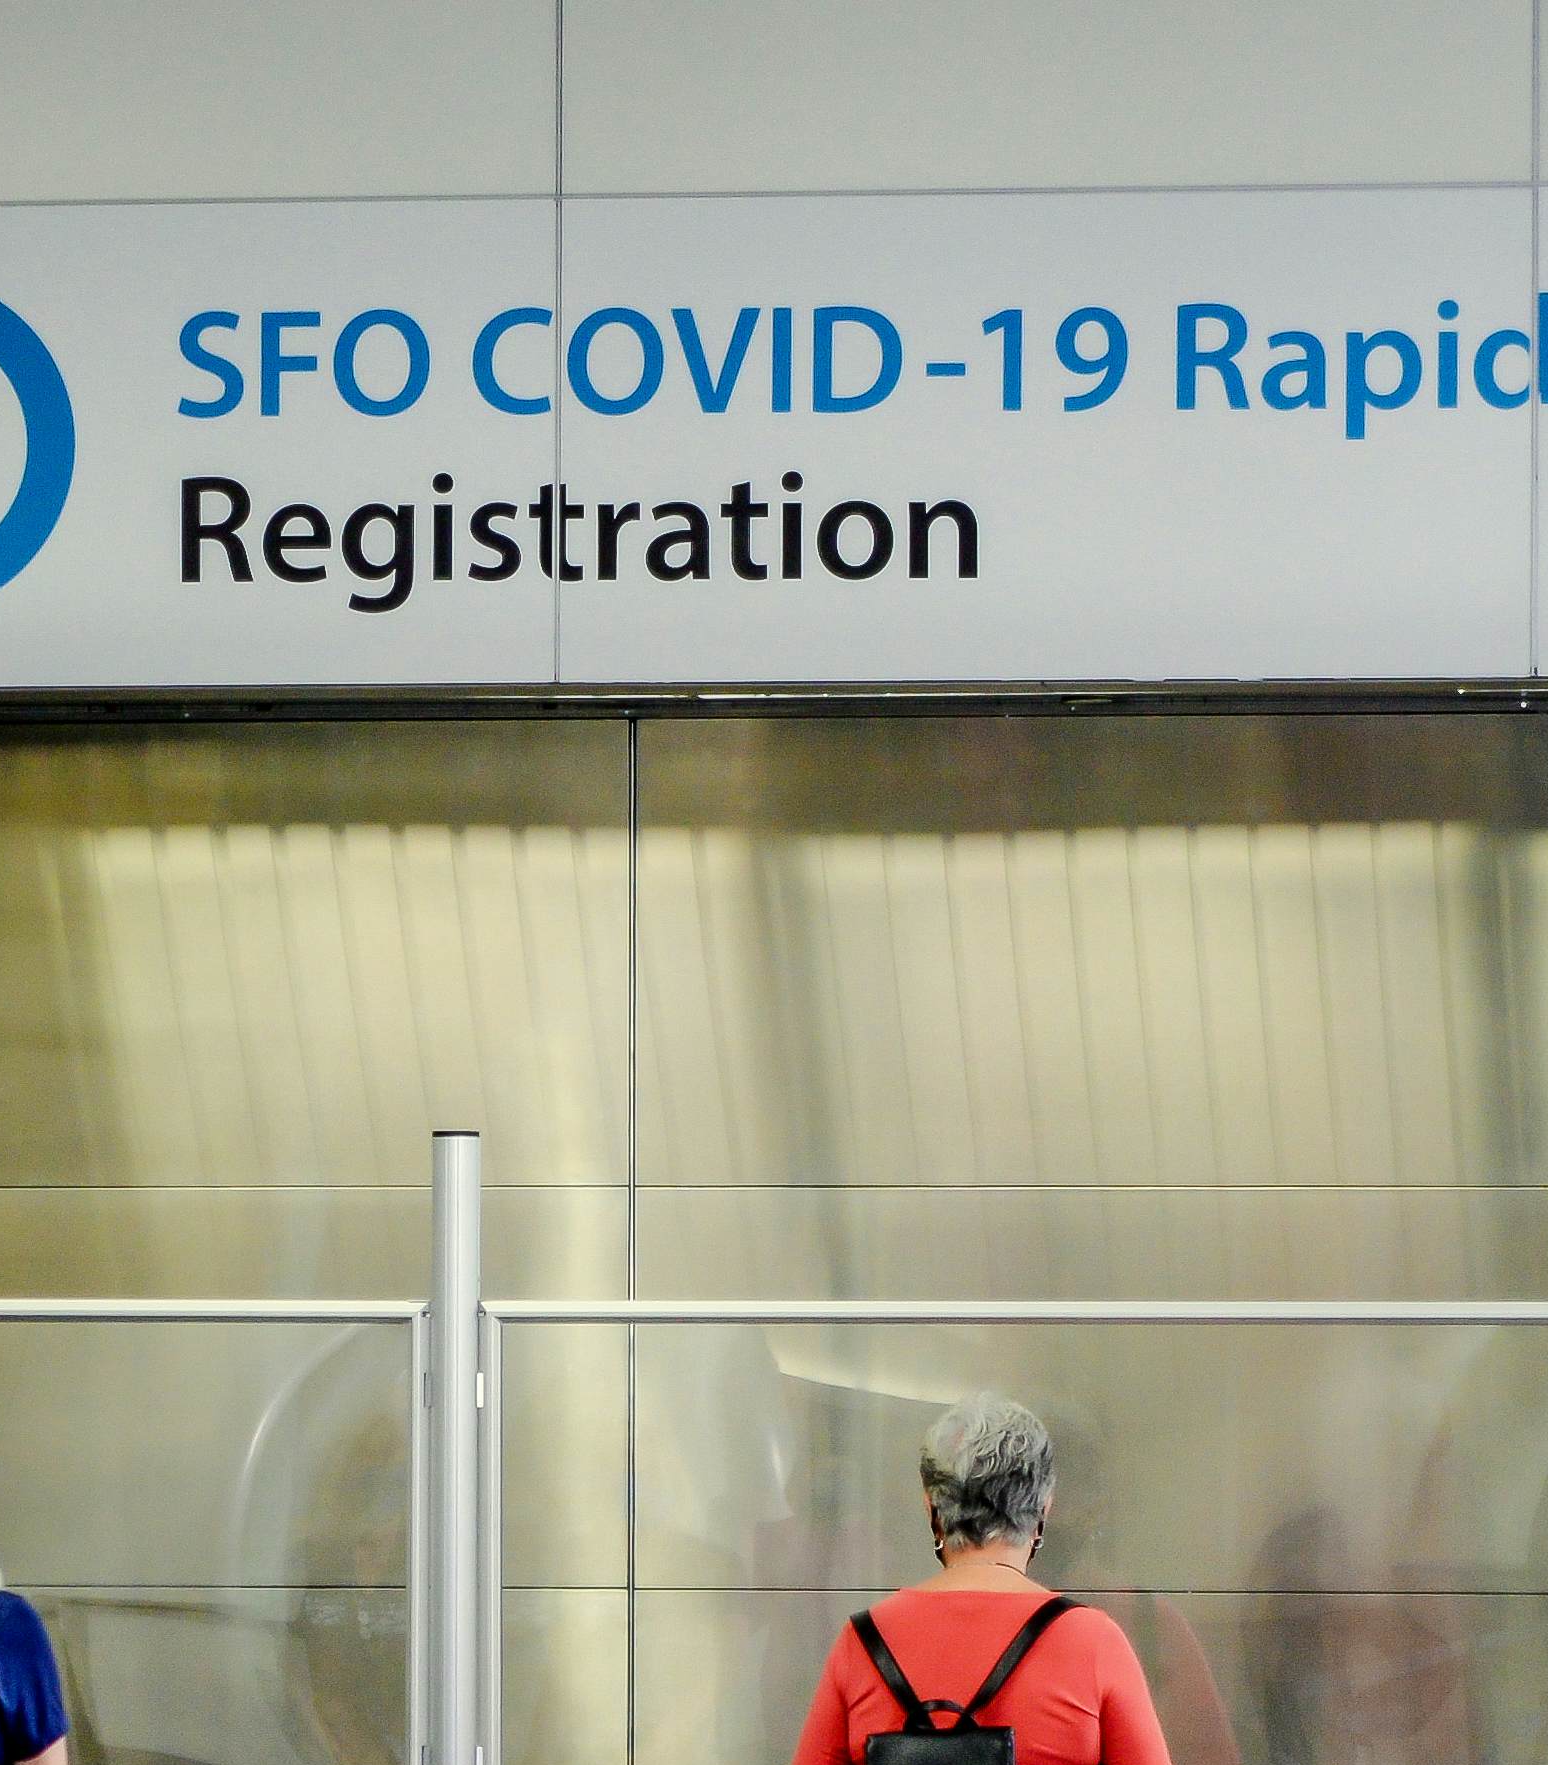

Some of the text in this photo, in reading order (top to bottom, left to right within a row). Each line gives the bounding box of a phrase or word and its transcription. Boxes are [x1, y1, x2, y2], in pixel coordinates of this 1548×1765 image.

[179, 308, 431, 419] SFO
[472, 305, 1129, 415] COVID-19
[182, 472, 977, 613] Registration
